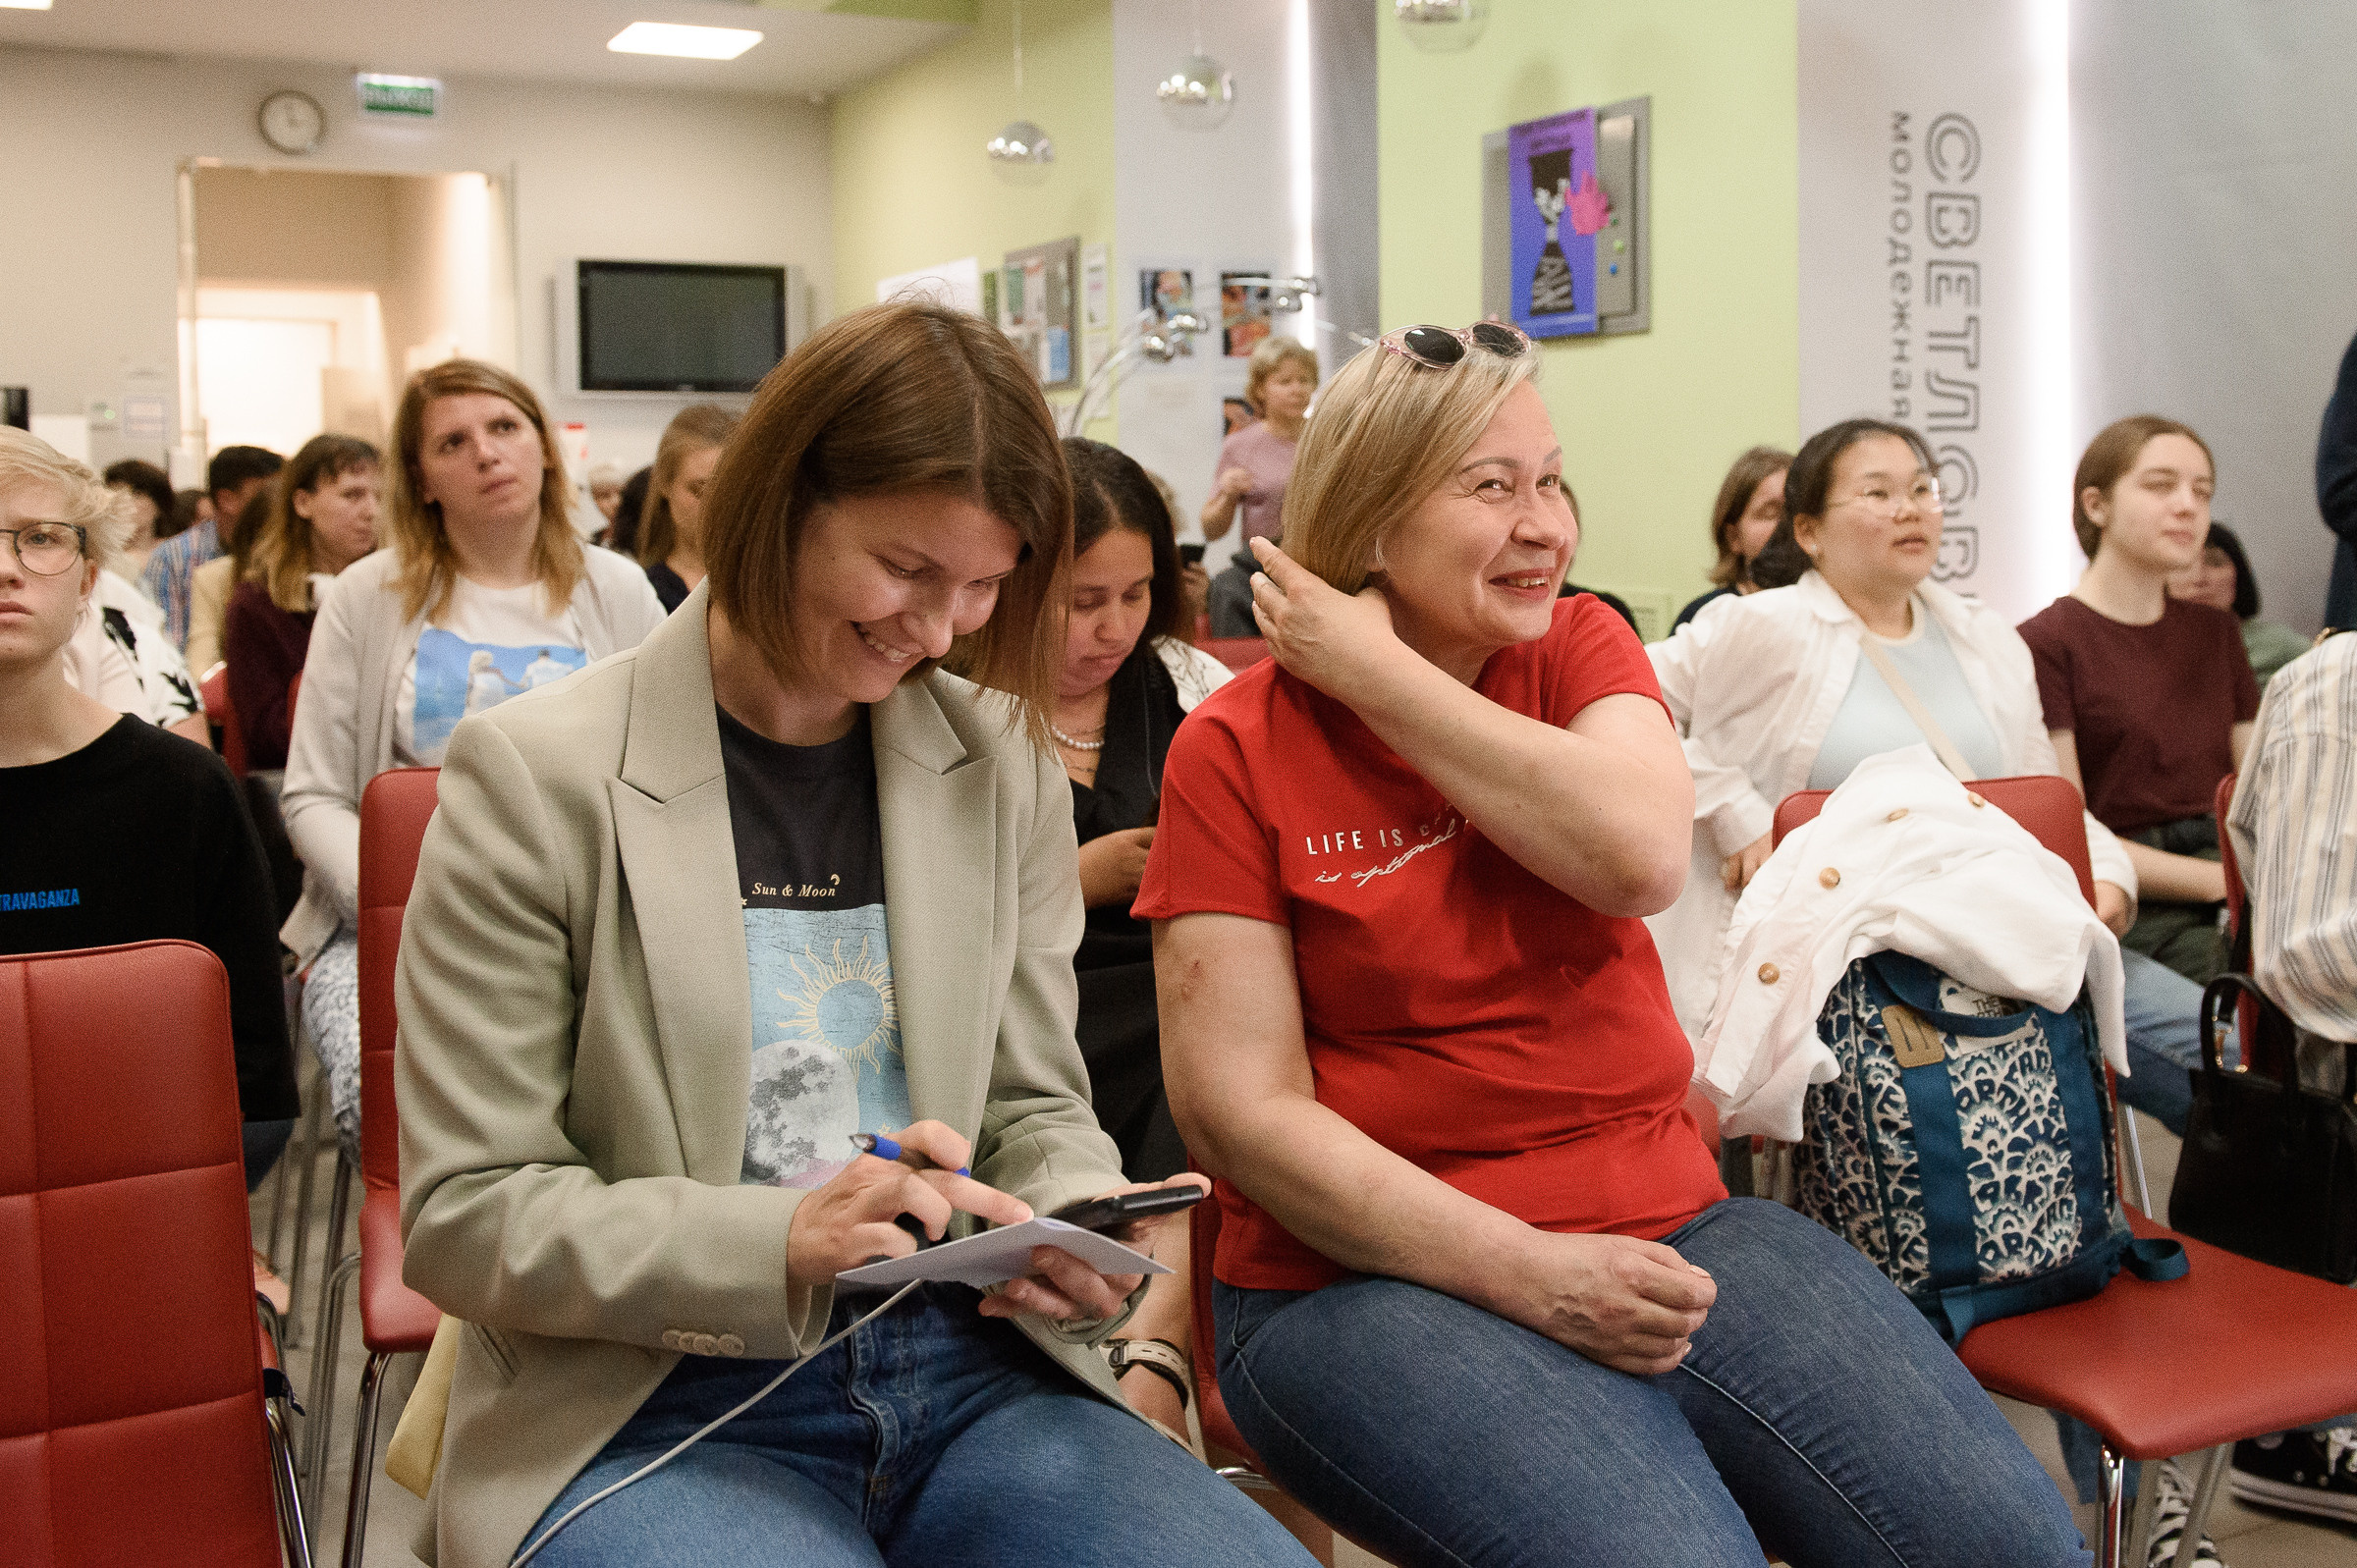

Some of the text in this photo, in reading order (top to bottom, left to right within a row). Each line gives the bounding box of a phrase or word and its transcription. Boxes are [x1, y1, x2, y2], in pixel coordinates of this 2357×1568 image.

[1924, 112, 1982, 598] СВЕТЛОВ
[1305, 828, 1403, 855] LIFE IS
[751, 882, 836, 897] Sun & Moon
